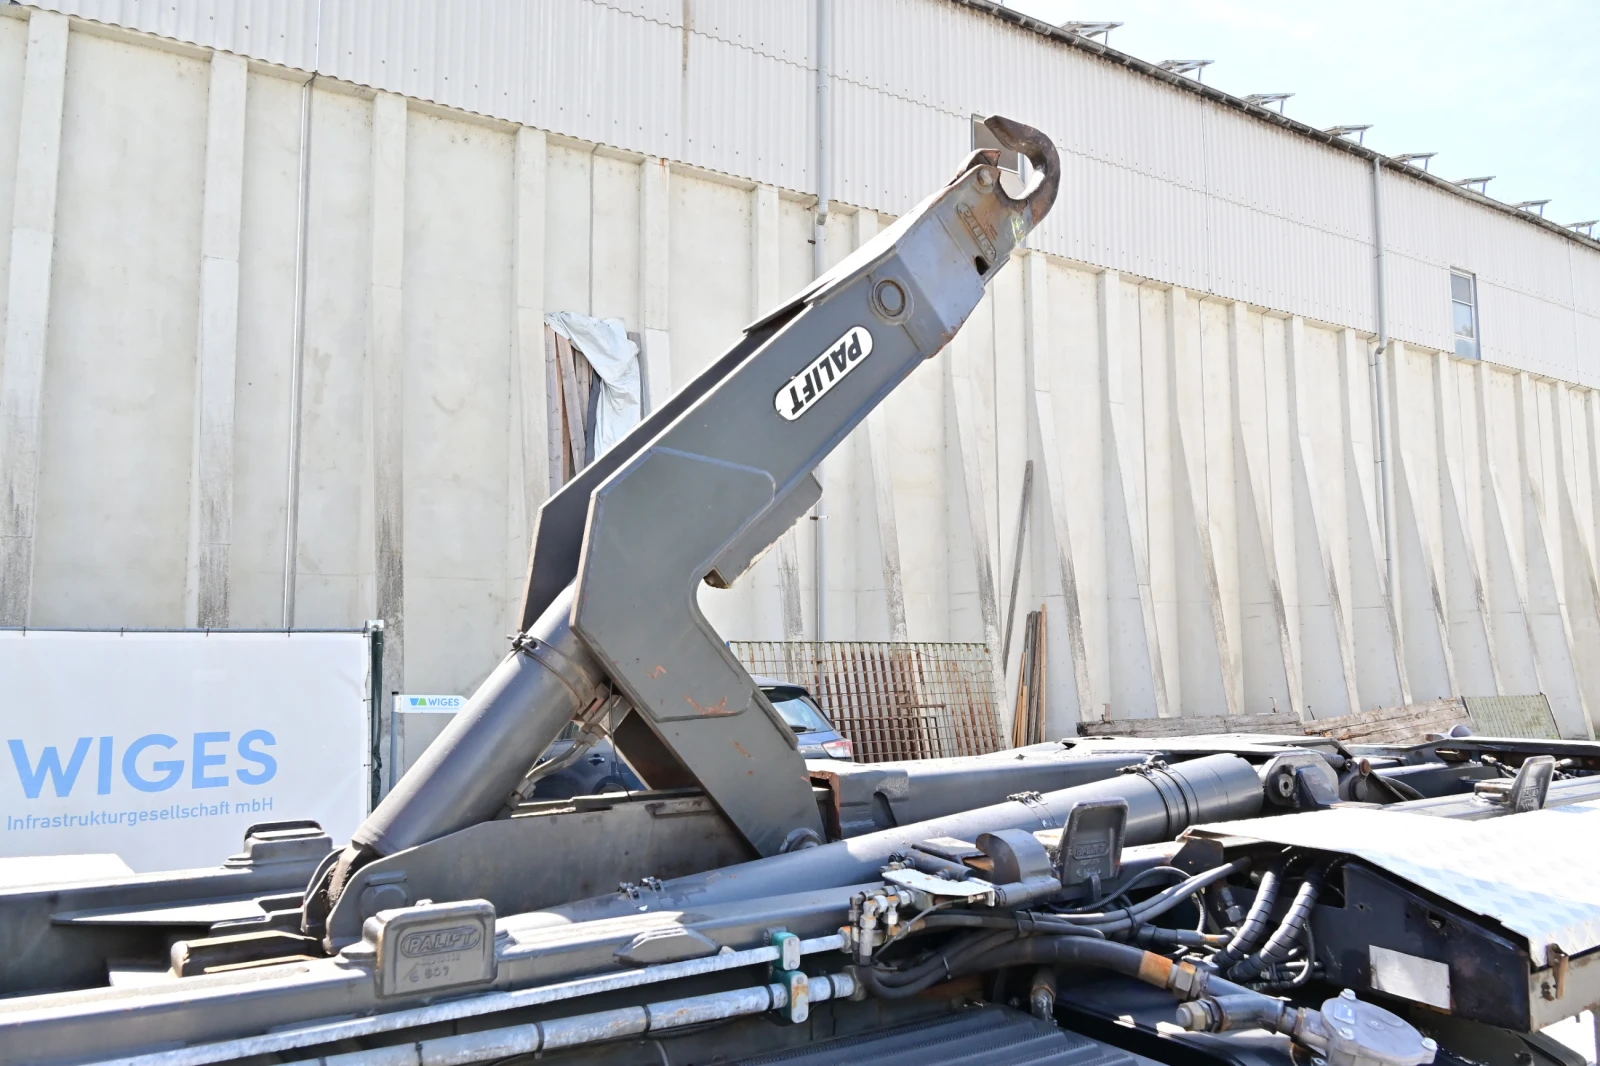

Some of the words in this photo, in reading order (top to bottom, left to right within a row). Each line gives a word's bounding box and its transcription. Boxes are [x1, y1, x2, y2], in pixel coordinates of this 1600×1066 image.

[789, 331, 863, 416] PALIFT
[428, 697, 460, 706] WIGES
[7, 729, 278, 799] WIGES
[7, 800, 230, 831] Infrastrukturgesellschaft
[235, 797, 274, 813] mbH
[407, 928, 477, 954] PALIFT
